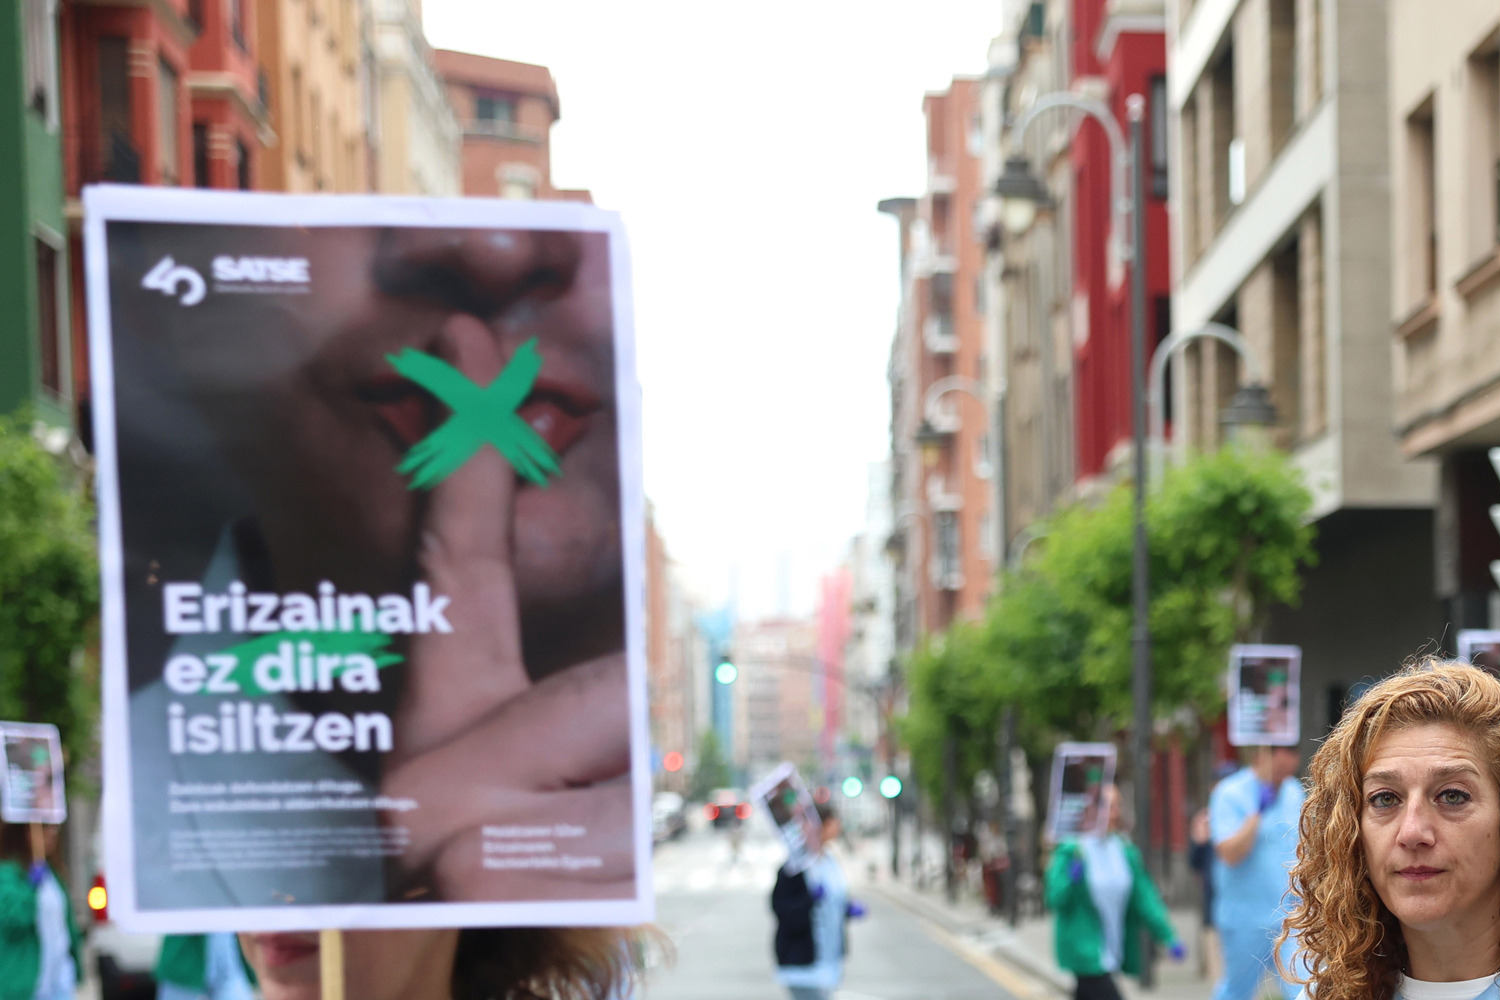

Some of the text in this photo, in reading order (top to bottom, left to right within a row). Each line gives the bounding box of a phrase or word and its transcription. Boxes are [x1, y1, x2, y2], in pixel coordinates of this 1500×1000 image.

[212, 255, 311, 283] SATSE
[163, 582, 453, 635] Erizainak
[164, 642, 379, 694] ez dira
[169, 702, 393, 753] isiltzen
